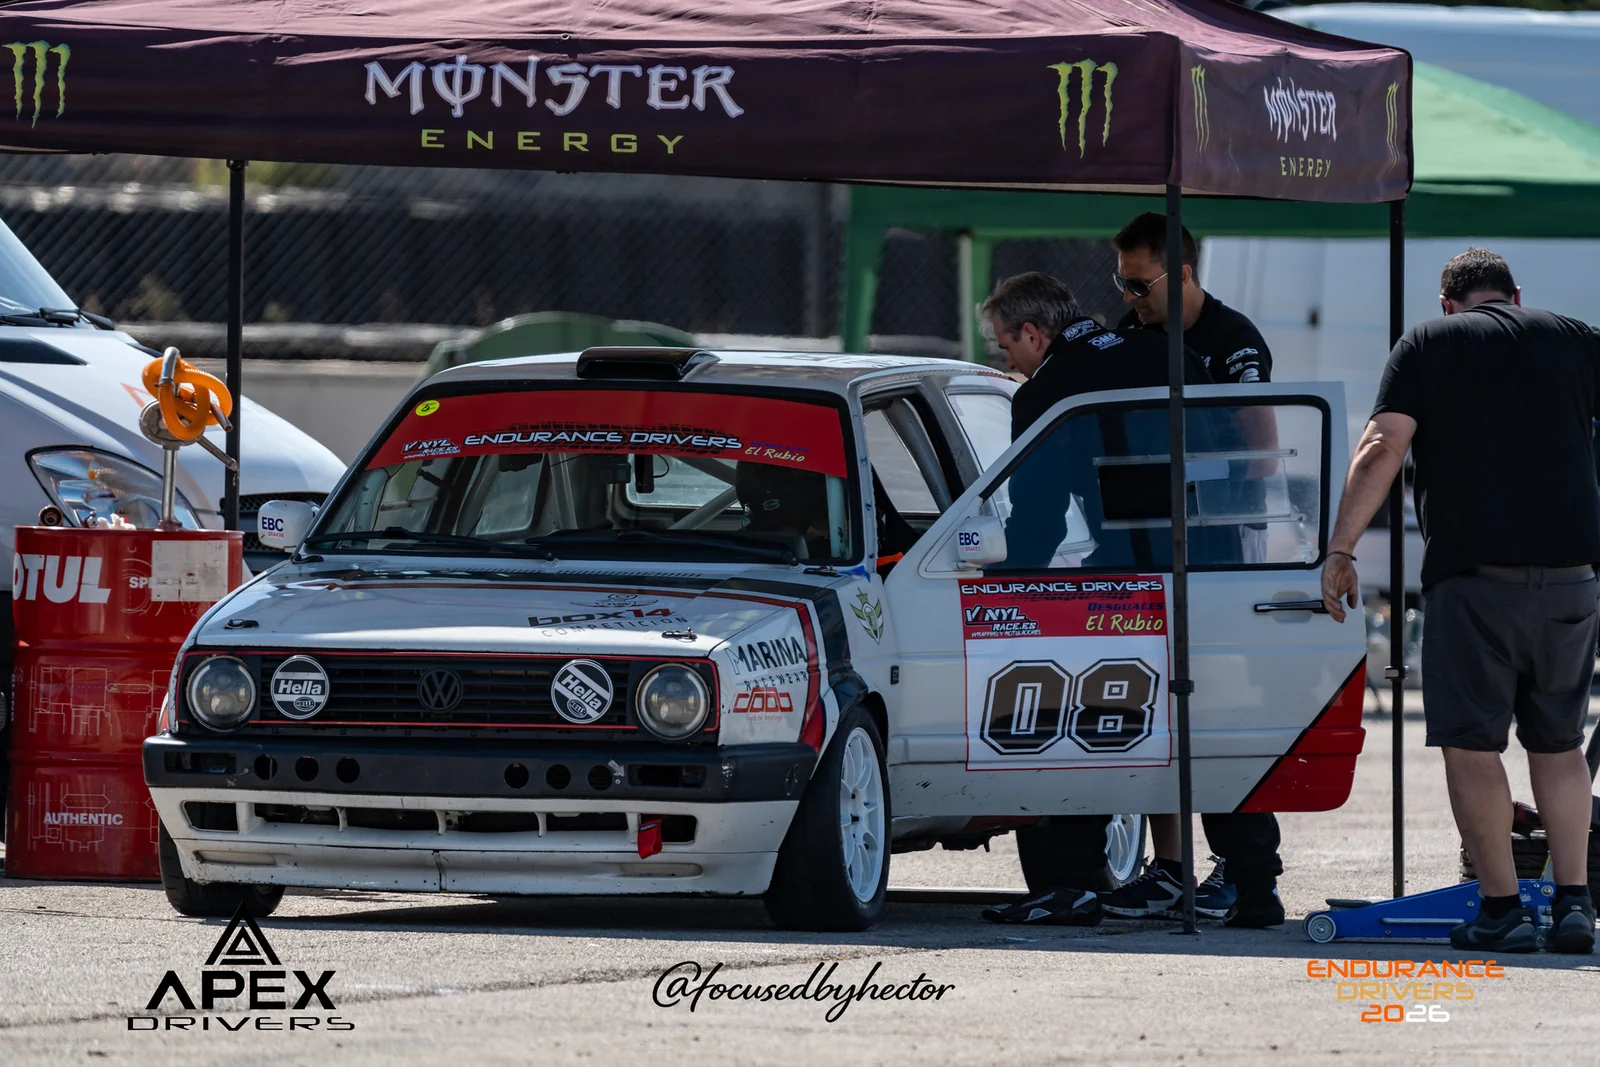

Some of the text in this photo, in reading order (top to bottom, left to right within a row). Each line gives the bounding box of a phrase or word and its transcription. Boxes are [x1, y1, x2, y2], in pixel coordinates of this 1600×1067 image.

[364, 54, 744, 118] MONSTER
[1263, 76, 1337, 144] MONSTER
[421, 128, 684, 154] ENERGY
[1280, 156, 1331, 178] ENERGY
[464, 431, 623, 445] ENDURANCE
[630, 432, 743, 449] DRIVERS
[744, 446, 762, 456] El
[763, 448, 806, 462] Rubio
[261, 516, 284, 532] EBC
[958, 531, 980, 546] EBC
[961, 580, 1163, 594] ENDURANCE DRIVERS
[541, 616, 688, 638] COMPETICION
[1085, 612, 1164, 634] El Rubio
[724, 636, 808, 675] MARINA
[278, 679, 322, 695] Hella
[561, 674, 602, 710] Hella
[744, 671, 808, 691] RACEWEAR
[980, 658, 1160, 755] 08
[44, 812, 124, 825] AUTHENTIC
